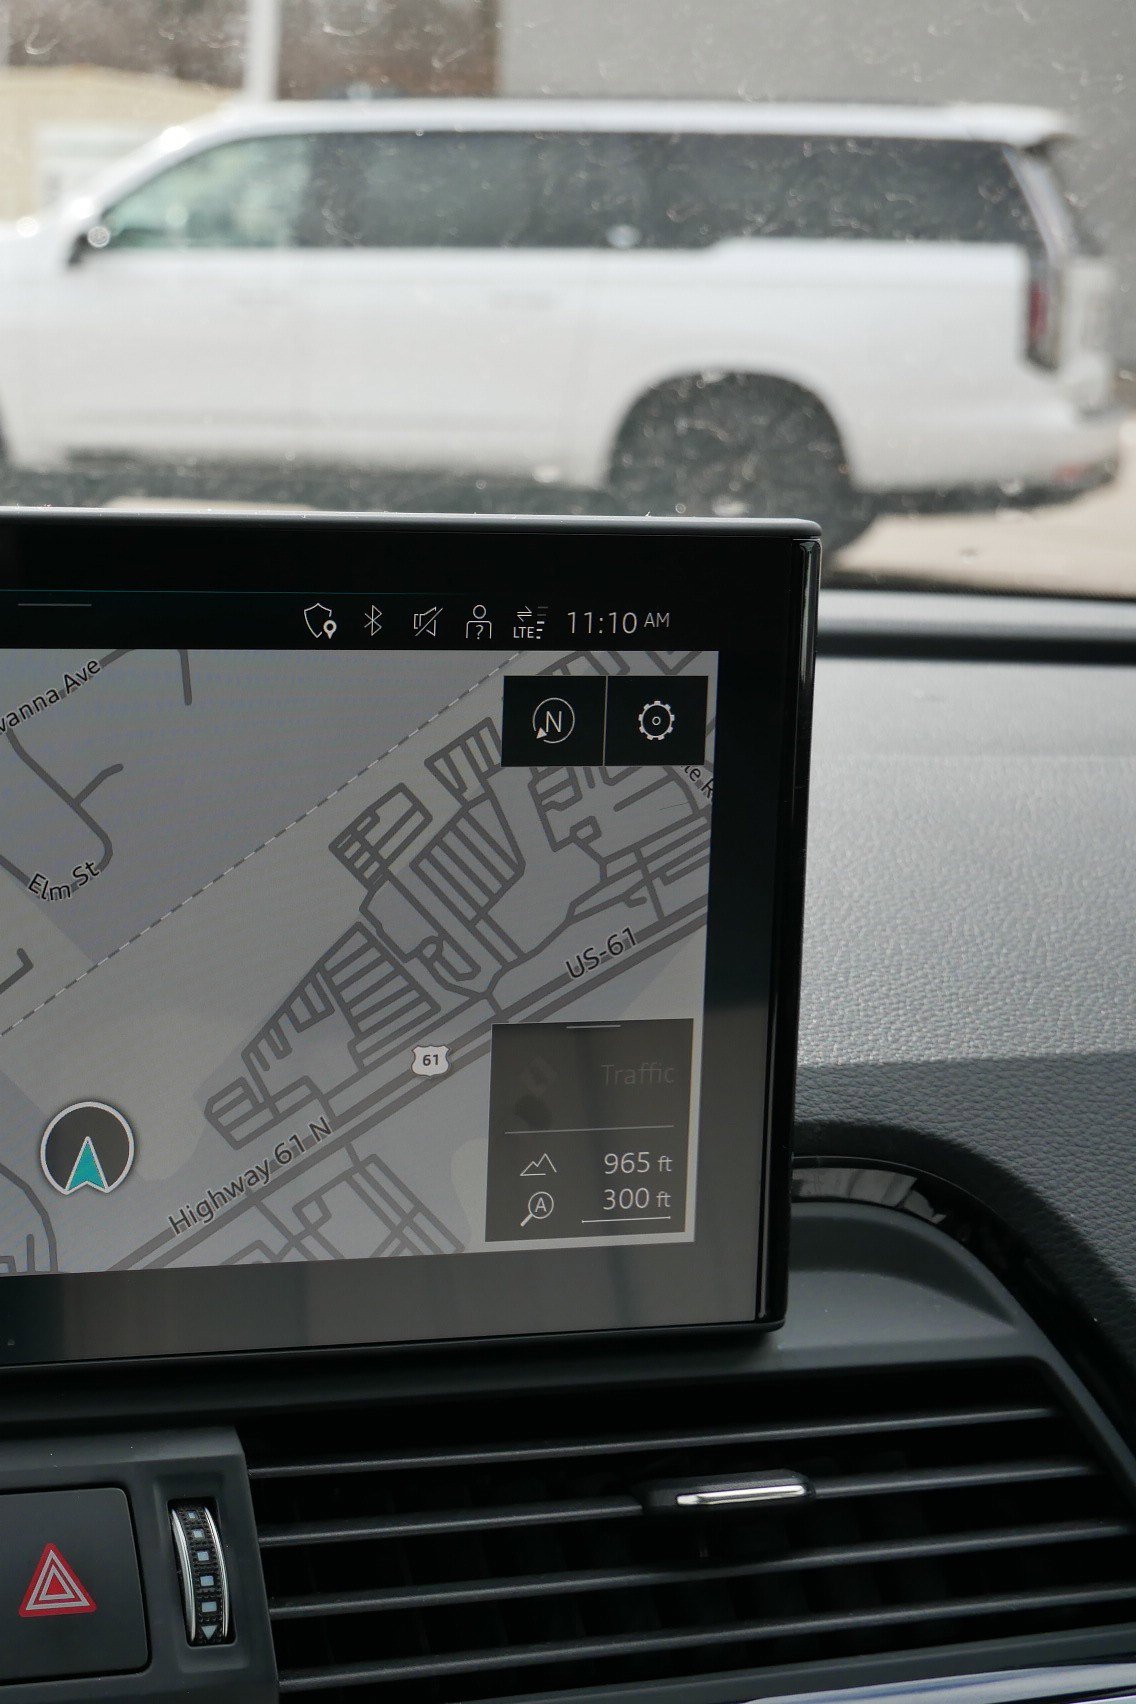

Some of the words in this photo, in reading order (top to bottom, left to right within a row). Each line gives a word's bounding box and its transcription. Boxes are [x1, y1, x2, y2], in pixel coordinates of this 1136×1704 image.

[513, 626, 535, 639] LTE
[567, 611, 638, 635] 11:10
[643, 612, 670, 628] AM
[63, 659, 102, 695] Ave
[545, 710, 563, 733] N
[27, 872, 71, 901] Elm
[71, 861, 101, 887] St
[565, 926, 637, 979] US-61
[422, 1053, 440, 1067] 61
[600, 1062, 676, 1087] Traffic
[168, 1158, 271, 1236] Highway
[273, 1133, 306, 1166] 61
[308, 1115, 333, 1143] N
[603, 1151, 651, 1176] 965
[656, 1155, 674, 1173] ft
[534, 1196, 548, 1214] A
[602, 1186, 651, 1211] 300
[655, 1190, 672, 1209] ft
